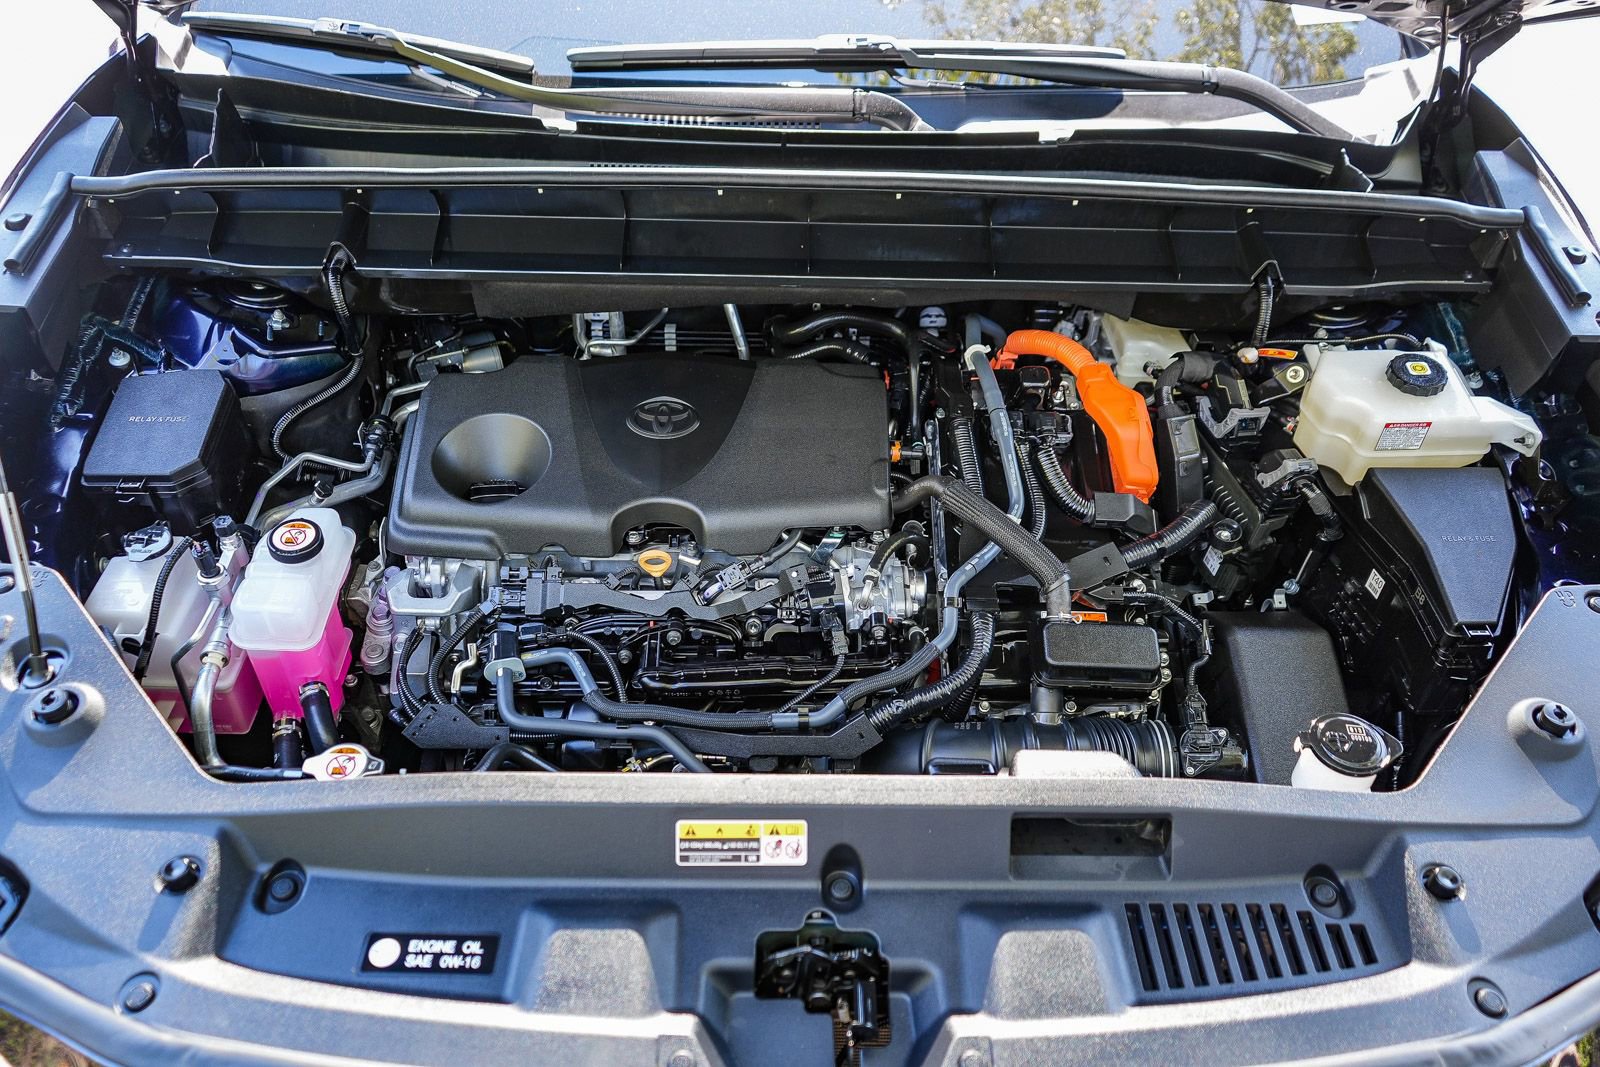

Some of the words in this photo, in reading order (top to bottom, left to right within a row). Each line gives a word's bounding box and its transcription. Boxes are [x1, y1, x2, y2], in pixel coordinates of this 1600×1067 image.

[1371, 570, 1385, 590] T40
[407, 939, 458, 954] ENGINE
[461, 940, 485, 955] OIL
[403, 953, 434, 968] SAE
